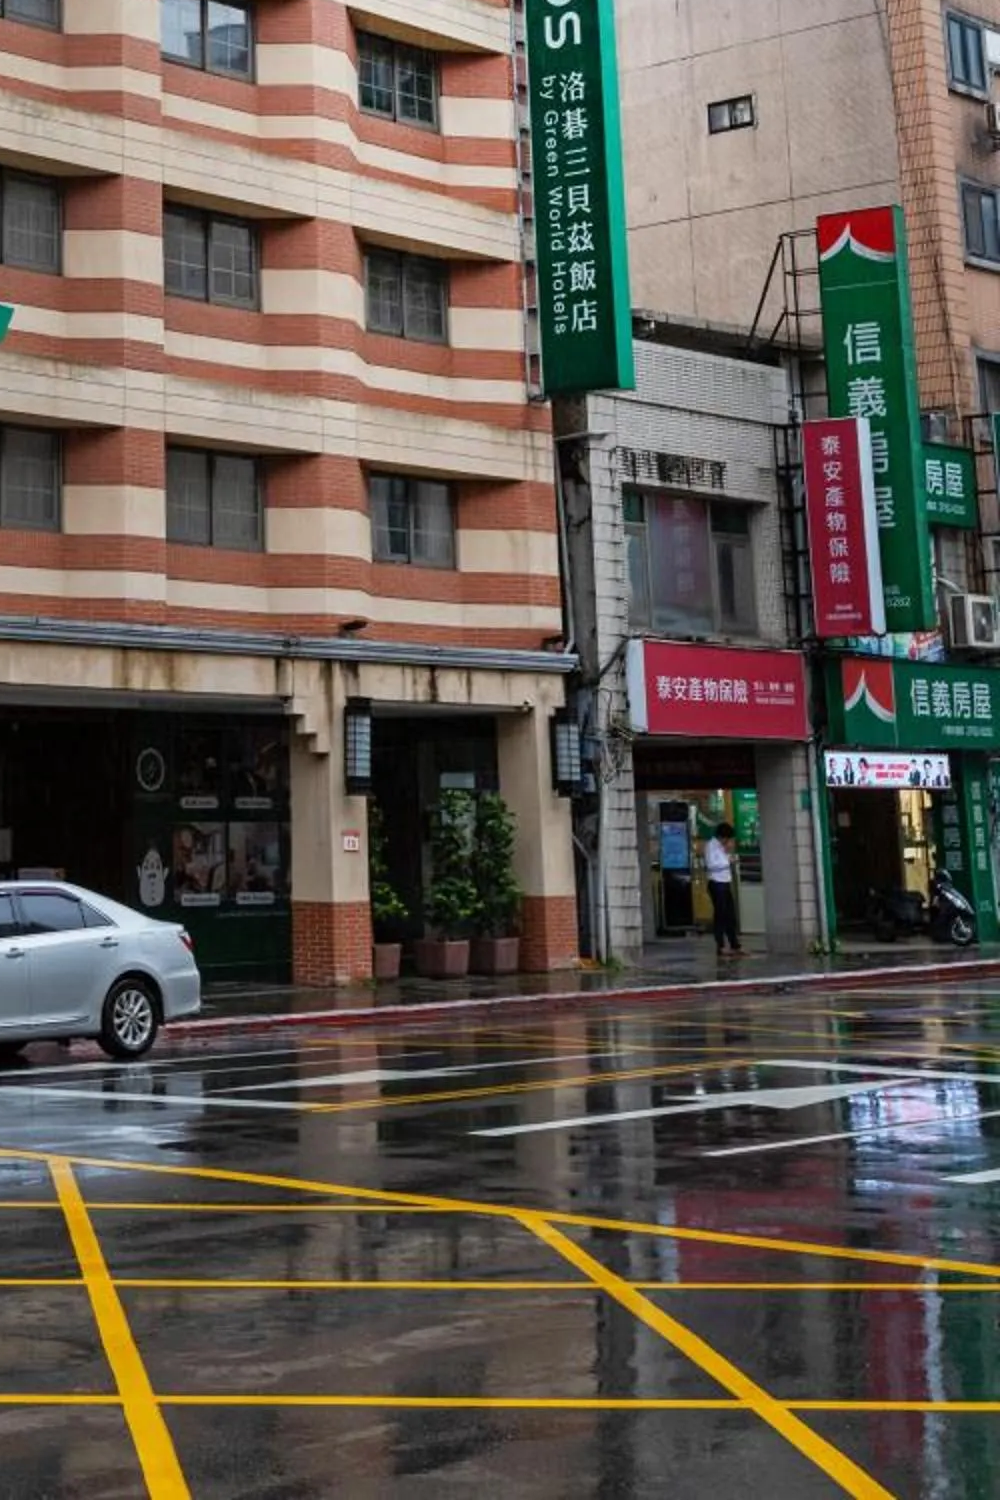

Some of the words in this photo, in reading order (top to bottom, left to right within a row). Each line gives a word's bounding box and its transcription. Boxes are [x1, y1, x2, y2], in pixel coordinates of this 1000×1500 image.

[541, 75, 554, 100] by
[544, 110, 559, 178] Green
[548, 185, 564, 252] World
[560, 71, 598, 333] 洛碁三貝茲飯店
[552, 261, 568, 335] Hotels
[821, 435, 852, 584] 泰安產物保險
[925, 459, 964, 497] 房屋
[656, 675, 749, 705] 泰安產物保險
[909, 678, 993, 720] 信義房屋
